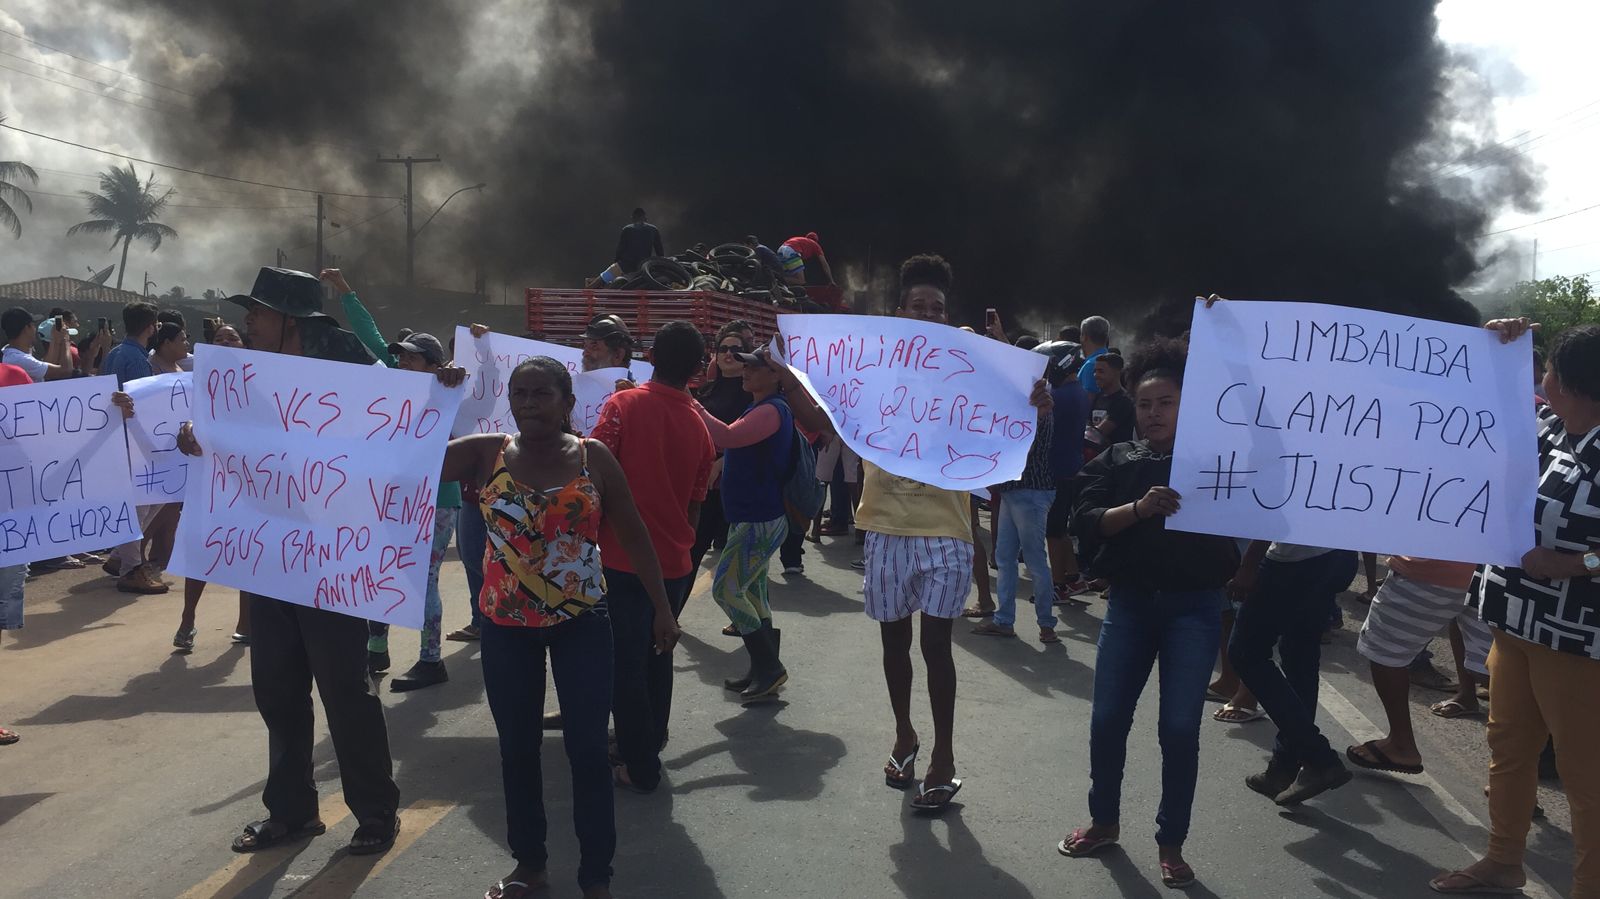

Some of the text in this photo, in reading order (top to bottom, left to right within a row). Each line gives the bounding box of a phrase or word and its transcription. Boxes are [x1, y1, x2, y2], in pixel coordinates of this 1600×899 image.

[207, 363, 441, 441] PRF VCS SAO
[880, 385, 1033, 441] QUEREMOS
[1216, 382, 1497, 453] CLAMA POR
[47, 501, 134, 544] CHORA
[205, 520, 417, 576] SEUS BANDO DE
